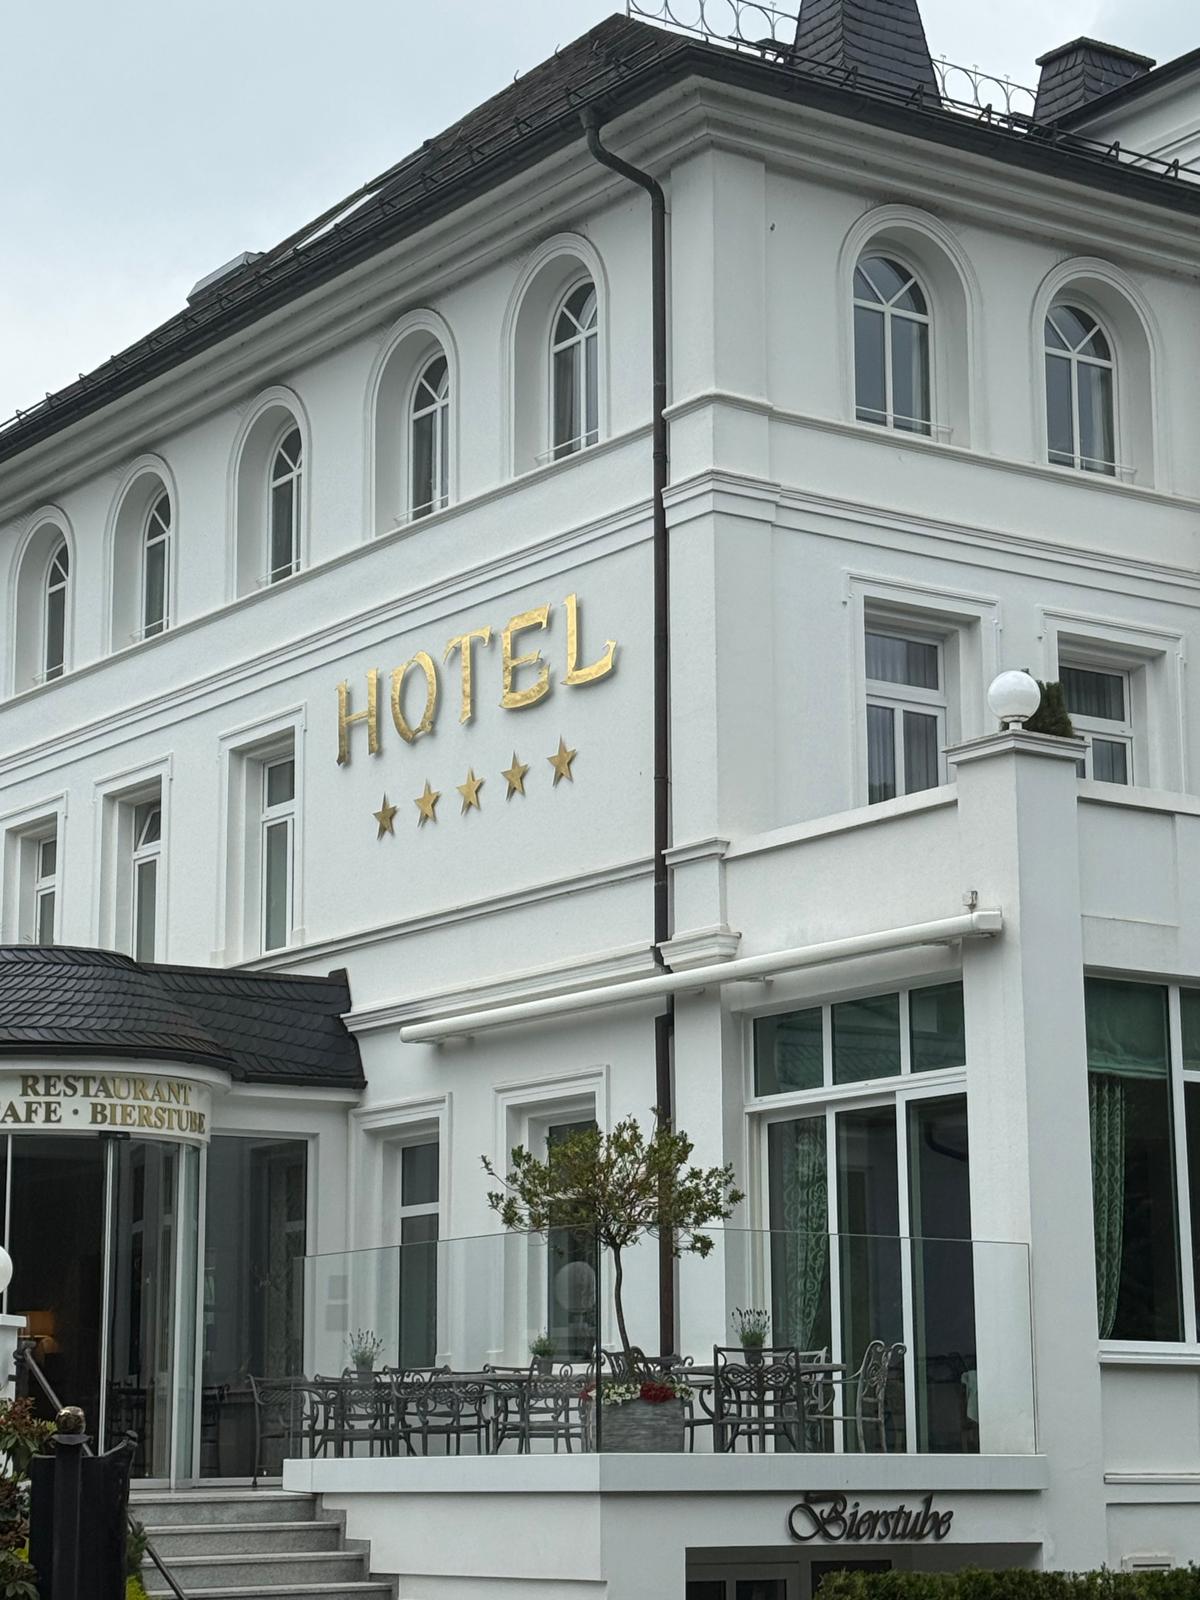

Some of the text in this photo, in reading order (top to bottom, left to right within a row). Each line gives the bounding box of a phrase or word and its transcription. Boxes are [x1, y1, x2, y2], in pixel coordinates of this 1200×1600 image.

[335, 592, 617, 767] HOTEL
[19, 1074, 192, 1106] RESTAURANT
[0, 1101, 206, 1134] AFE BIERSTUBE
[788, 1492, 954, 1541] Bierstube
